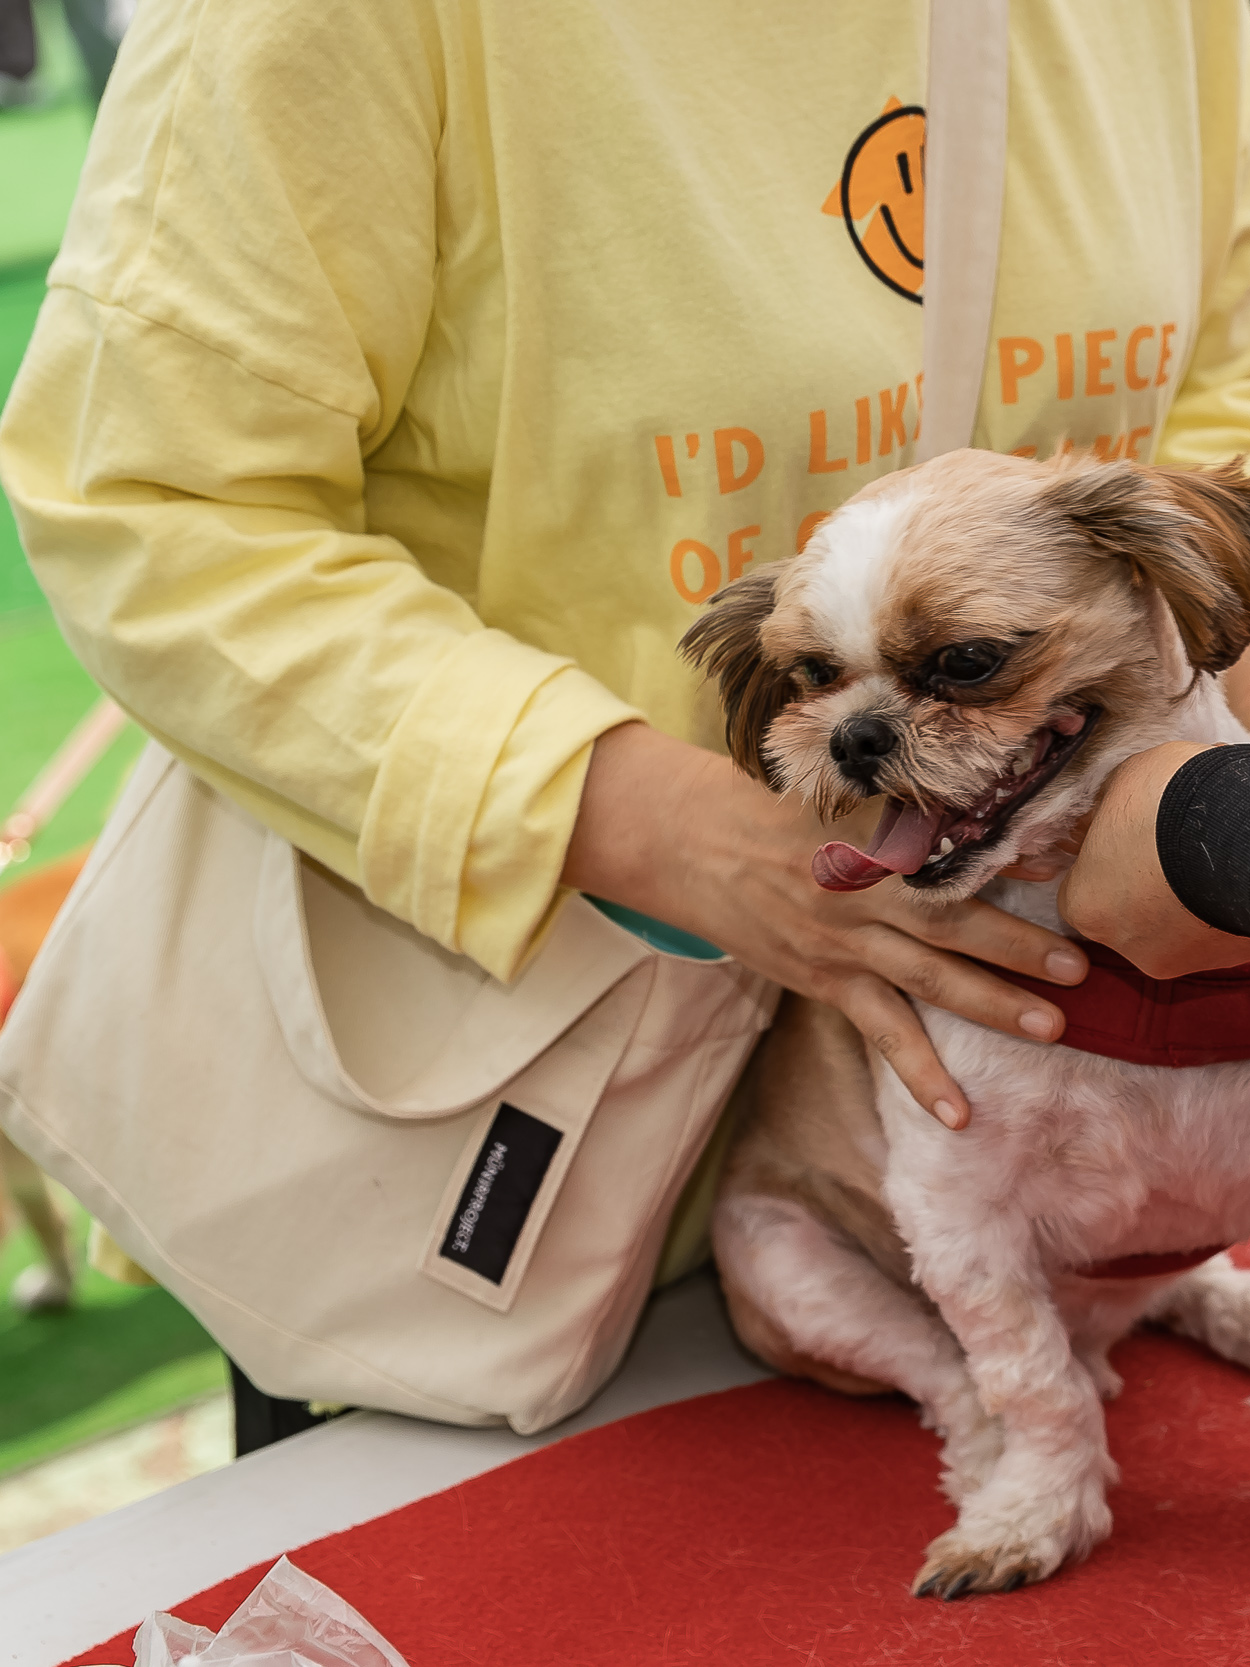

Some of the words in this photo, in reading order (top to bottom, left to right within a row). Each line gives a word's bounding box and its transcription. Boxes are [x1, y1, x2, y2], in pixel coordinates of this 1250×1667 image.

[654, 426, 765, 497] I'D
[807, 371, 925, 475] LIK
[997, 323, 1177, 405] PIECE
[669, 524, 762, 605] OF
